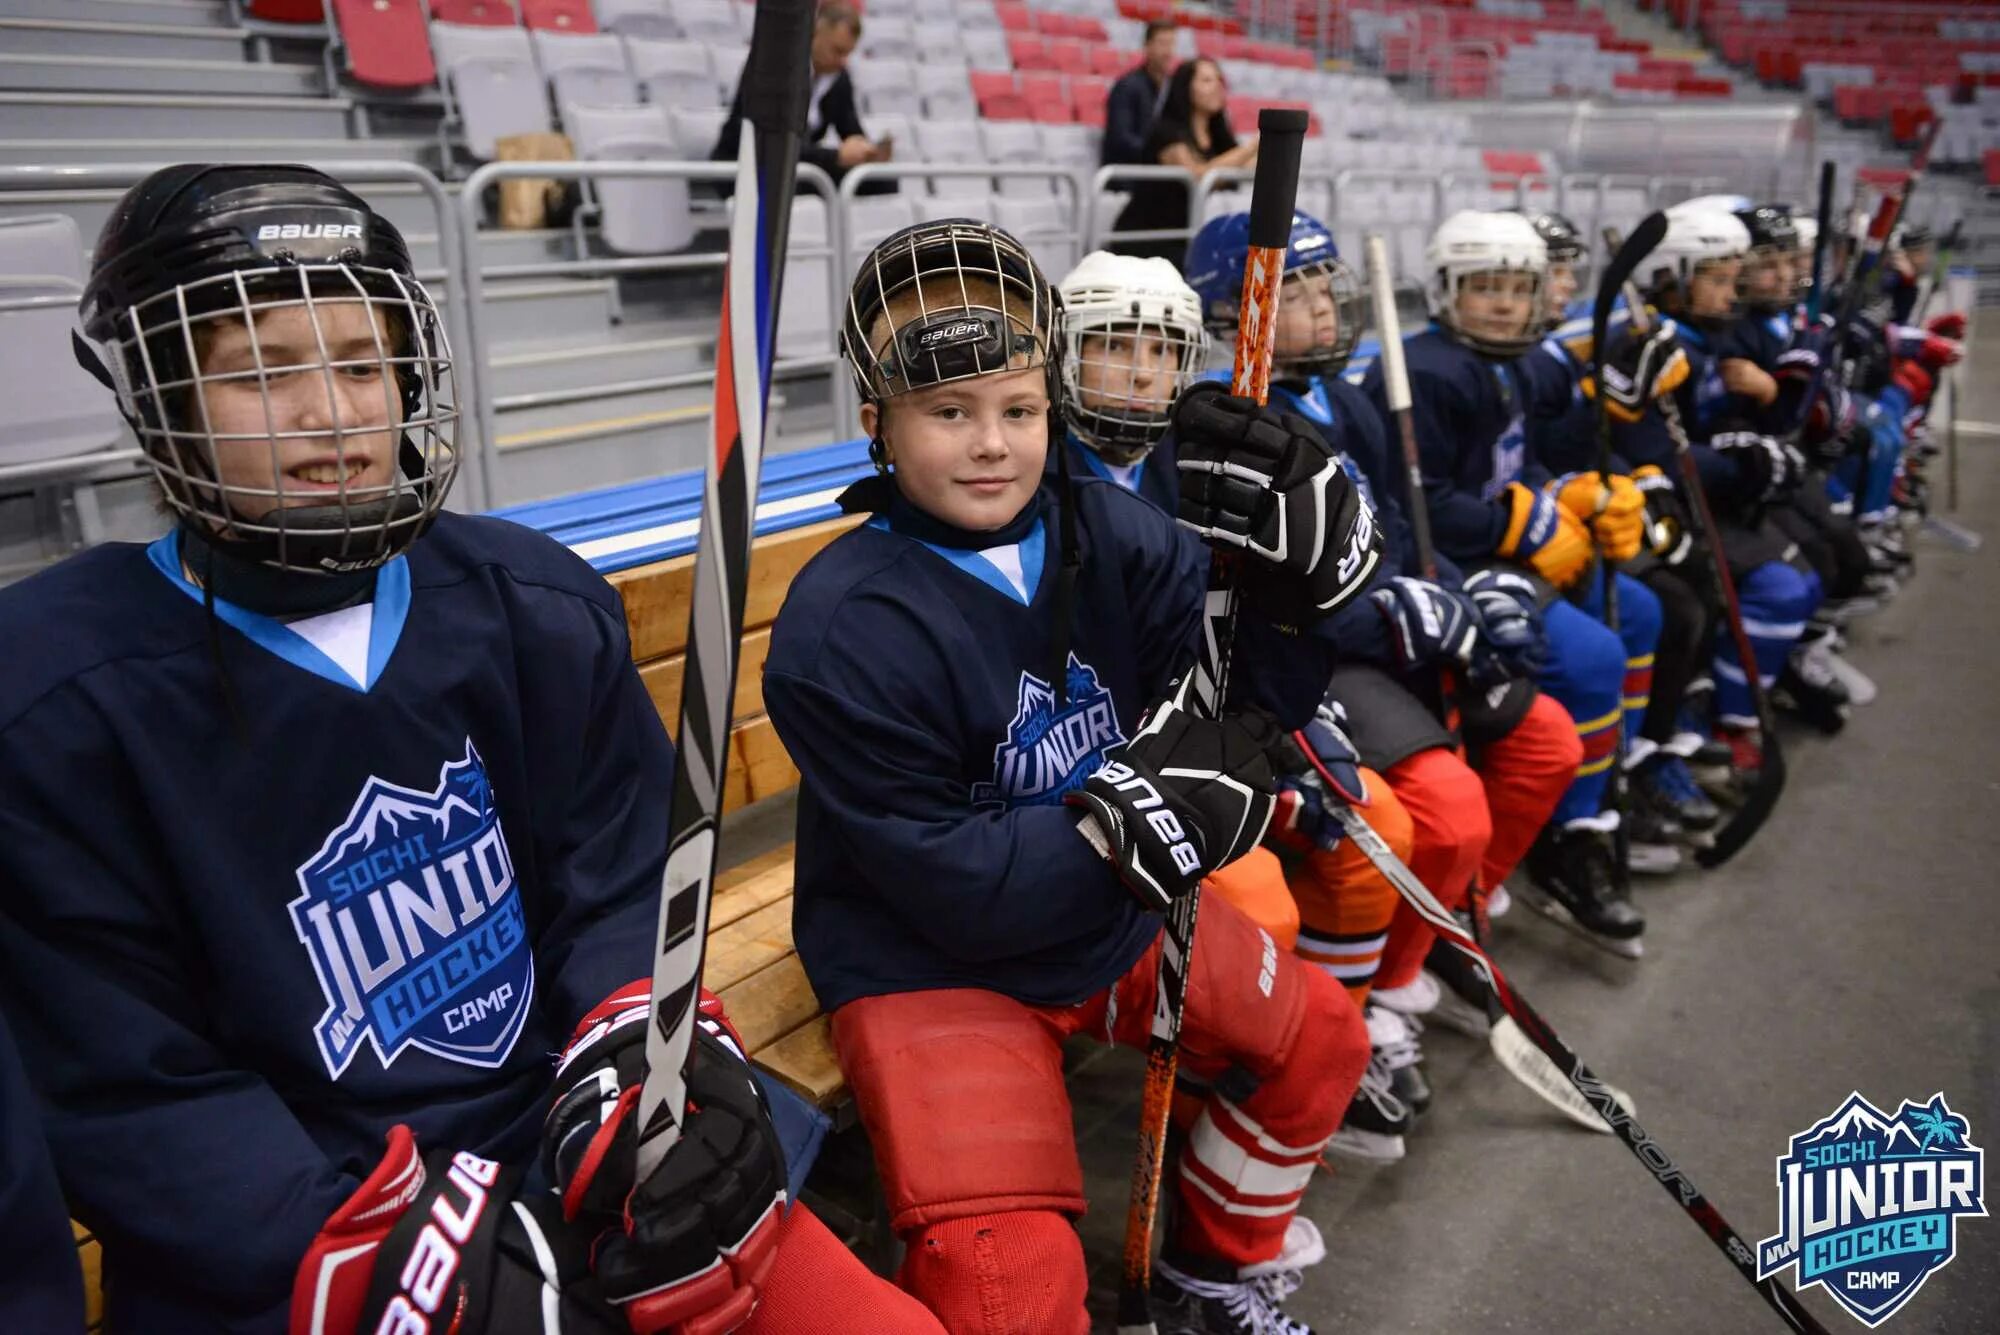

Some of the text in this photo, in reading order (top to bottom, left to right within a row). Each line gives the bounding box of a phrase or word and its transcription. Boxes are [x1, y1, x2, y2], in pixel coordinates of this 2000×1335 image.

[257, 223, 362, 240] BAUER
[920, 323, 981, 344] BAUER
[1001, 700, 1114, 798] JUNIOR
[327, 832, 433, 902] SOCHI
[442, 982, 513, 1035] CAMP
[1569, 1056, 1699, 1207] VAPOR
